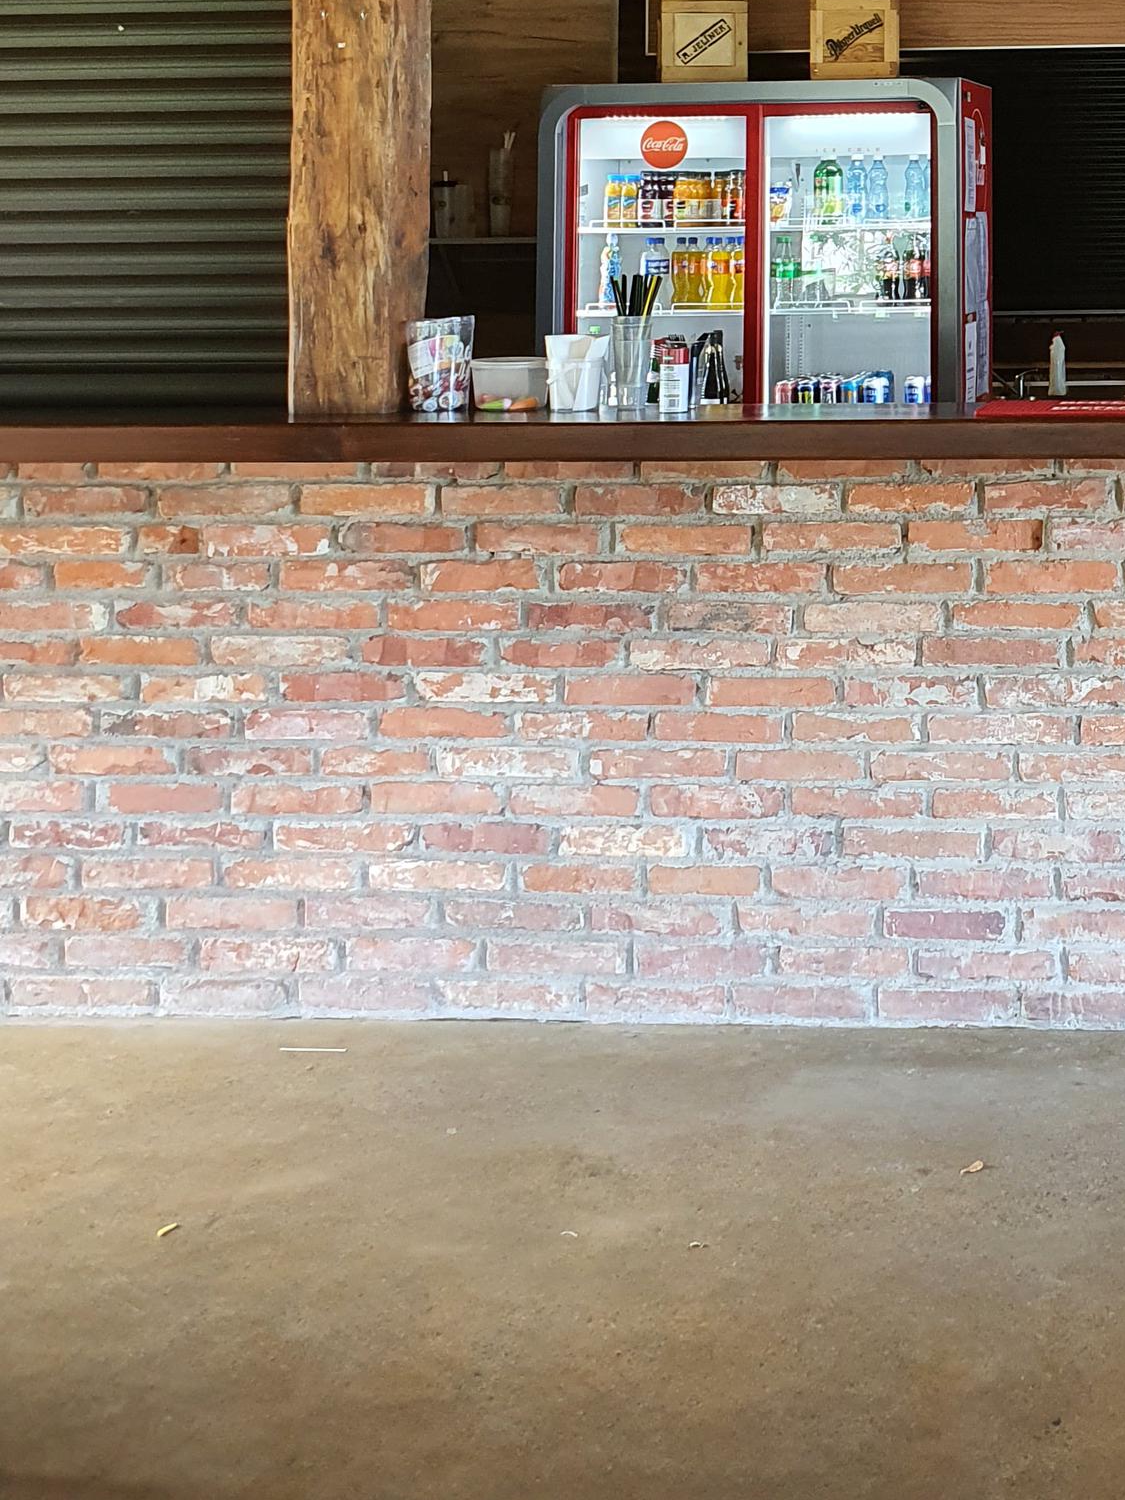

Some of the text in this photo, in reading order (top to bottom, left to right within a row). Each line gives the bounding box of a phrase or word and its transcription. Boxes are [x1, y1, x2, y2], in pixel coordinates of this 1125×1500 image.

[849, 13, 882, 36] Urquell
[692, 24, 727, 53] JELÍNEK
[643, 136, 685, 152] Coca-Cola
